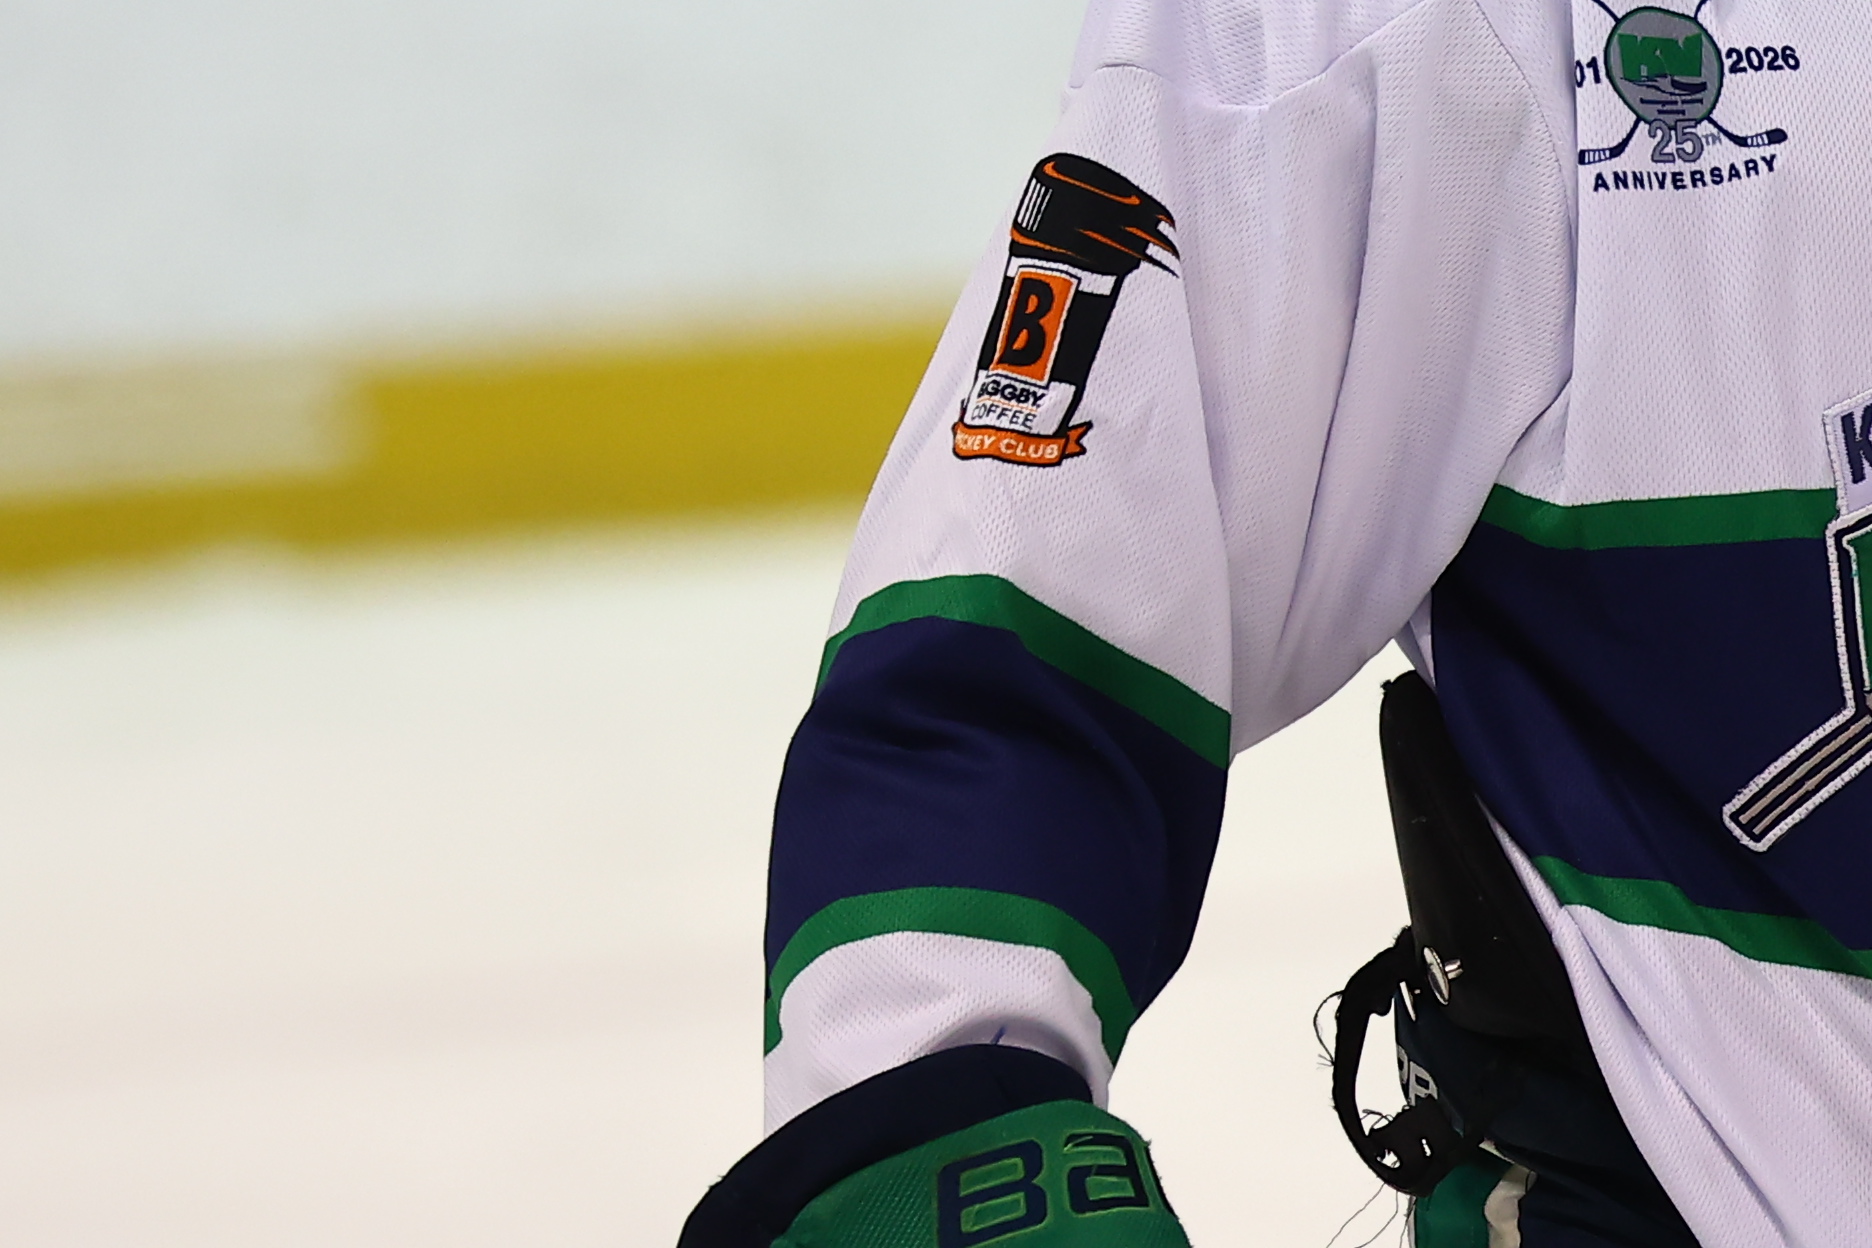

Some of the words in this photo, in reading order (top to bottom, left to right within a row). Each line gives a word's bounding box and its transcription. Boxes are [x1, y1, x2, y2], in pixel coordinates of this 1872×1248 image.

[1724, 45, 1801, 74] 2026
[1592, 153, 1778, 193] ANNIVERSARY
[999, 437, 1060, 460] CLUB
